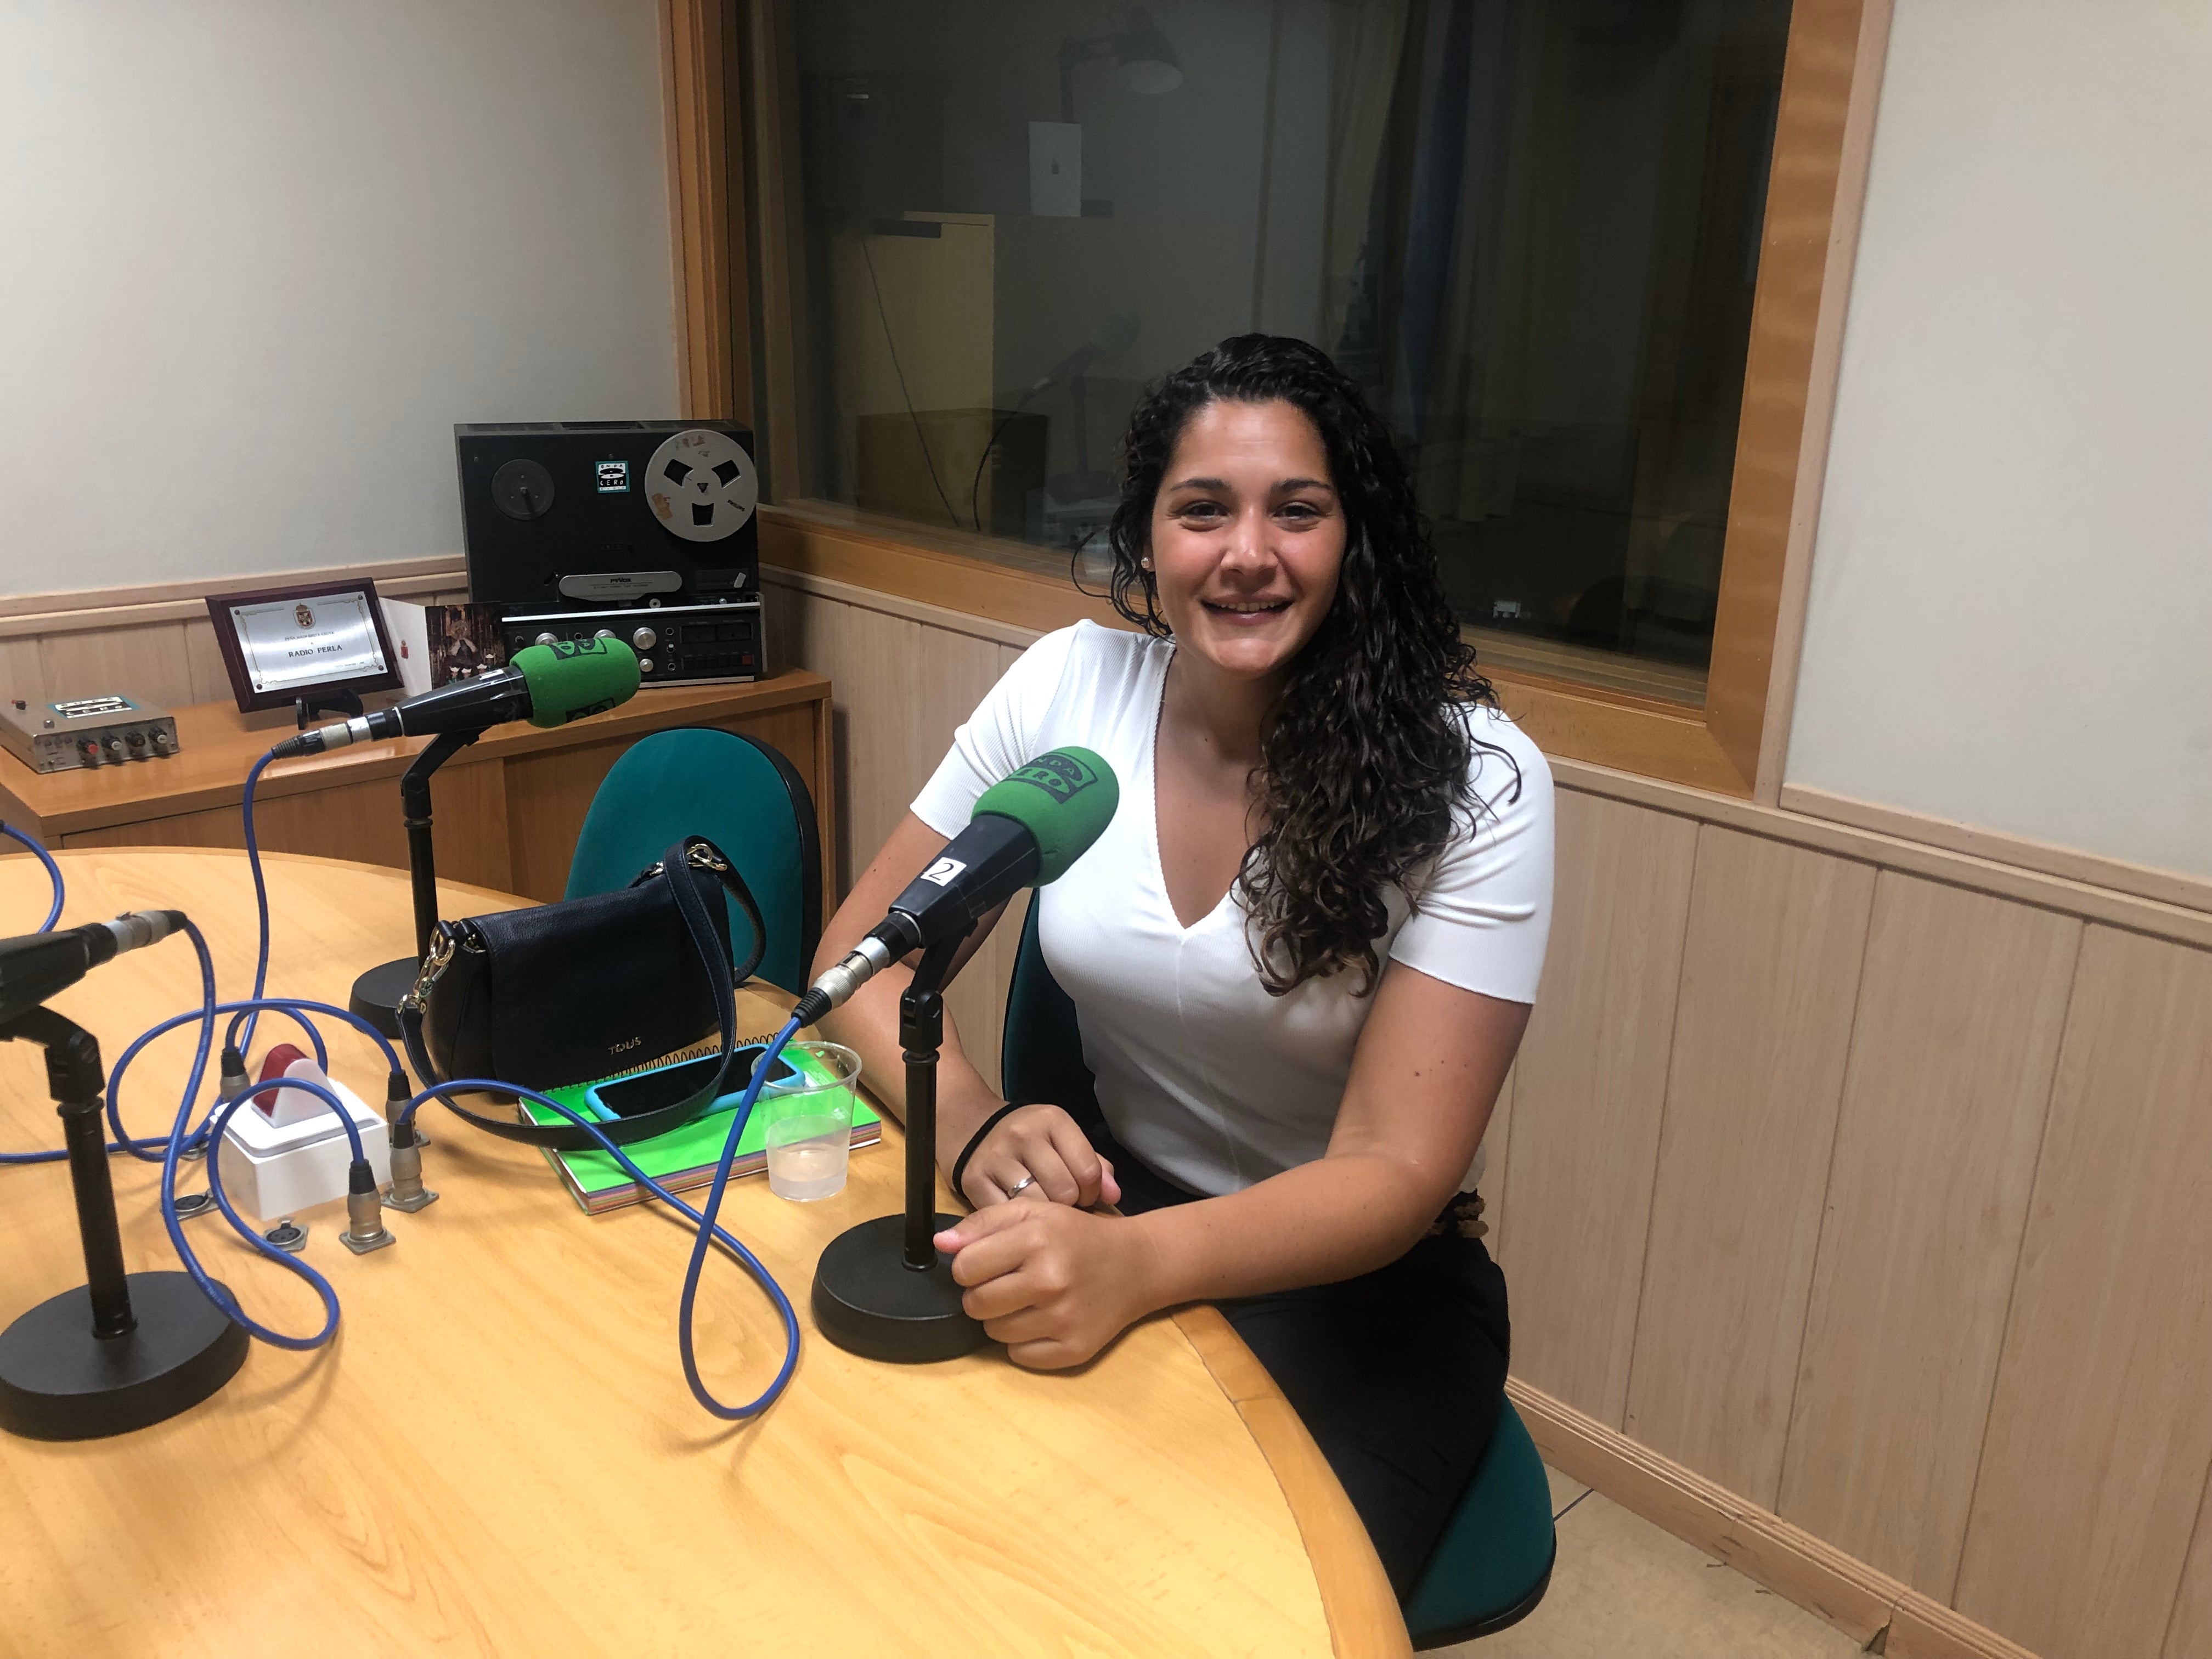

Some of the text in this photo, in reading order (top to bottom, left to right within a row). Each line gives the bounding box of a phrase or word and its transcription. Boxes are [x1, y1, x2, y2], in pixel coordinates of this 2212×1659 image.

[288, 645, 343, 658] RADIO PERLA
[928, 862, 955, 881] 2
[607, 1036, 641, 1056] TOUS
